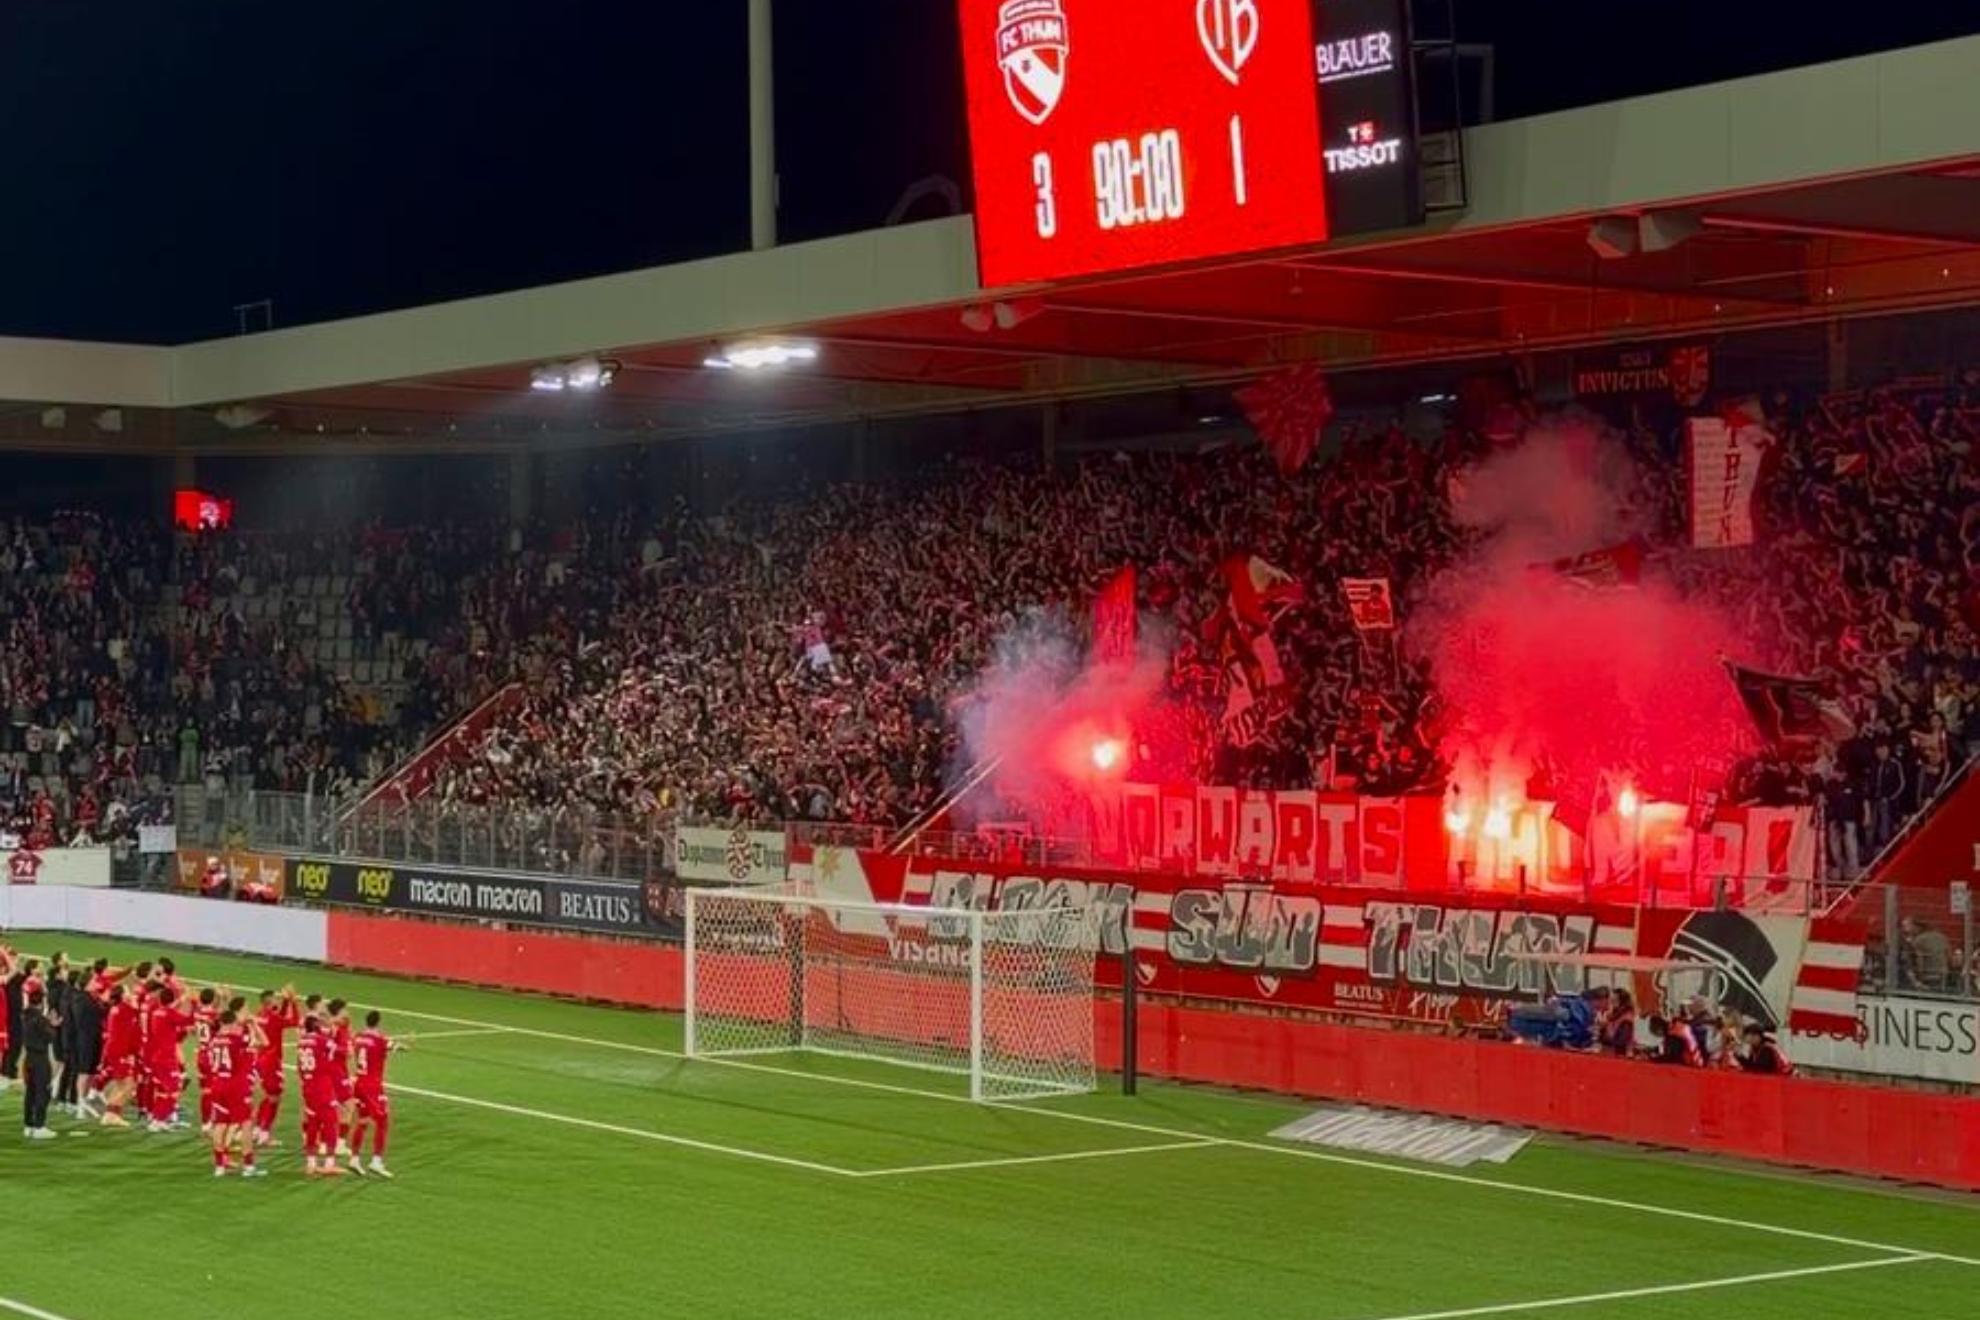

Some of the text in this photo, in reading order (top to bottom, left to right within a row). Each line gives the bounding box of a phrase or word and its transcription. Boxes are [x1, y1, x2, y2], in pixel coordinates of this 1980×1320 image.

[1001, 19, 1062, 53] FC THUN
[1323, 139, 1400, 173] TISSOT
[1032, 152, 1057, 239] 3
[1092, 128, 1185, 230] 90:00
[1579, 367, 1668, 393] INVICTUS
[410, 878, 542, 915] macron macron
[560, 892, 630, 924] BEATUS
[1364, 901, 1593, 996] THUN
